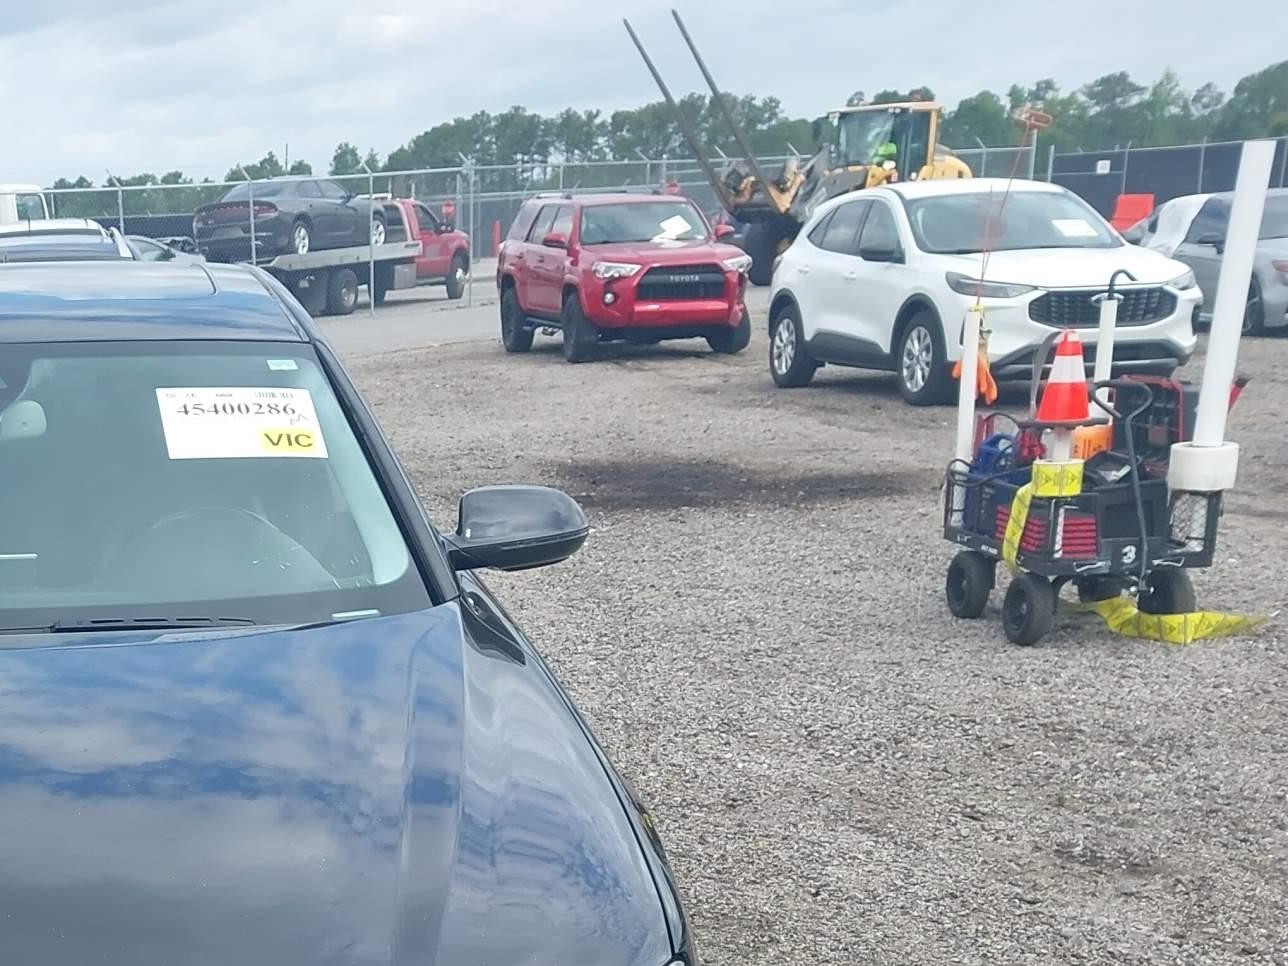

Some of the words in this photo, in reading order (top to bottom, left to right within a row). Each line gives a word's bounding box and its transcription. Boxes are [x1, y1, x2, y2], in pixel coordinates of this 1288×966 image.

[176, 402, 296, 416] 45400286
[264, 433, 313, 448] VIC
[1121, 545, 1137, 564] 3
